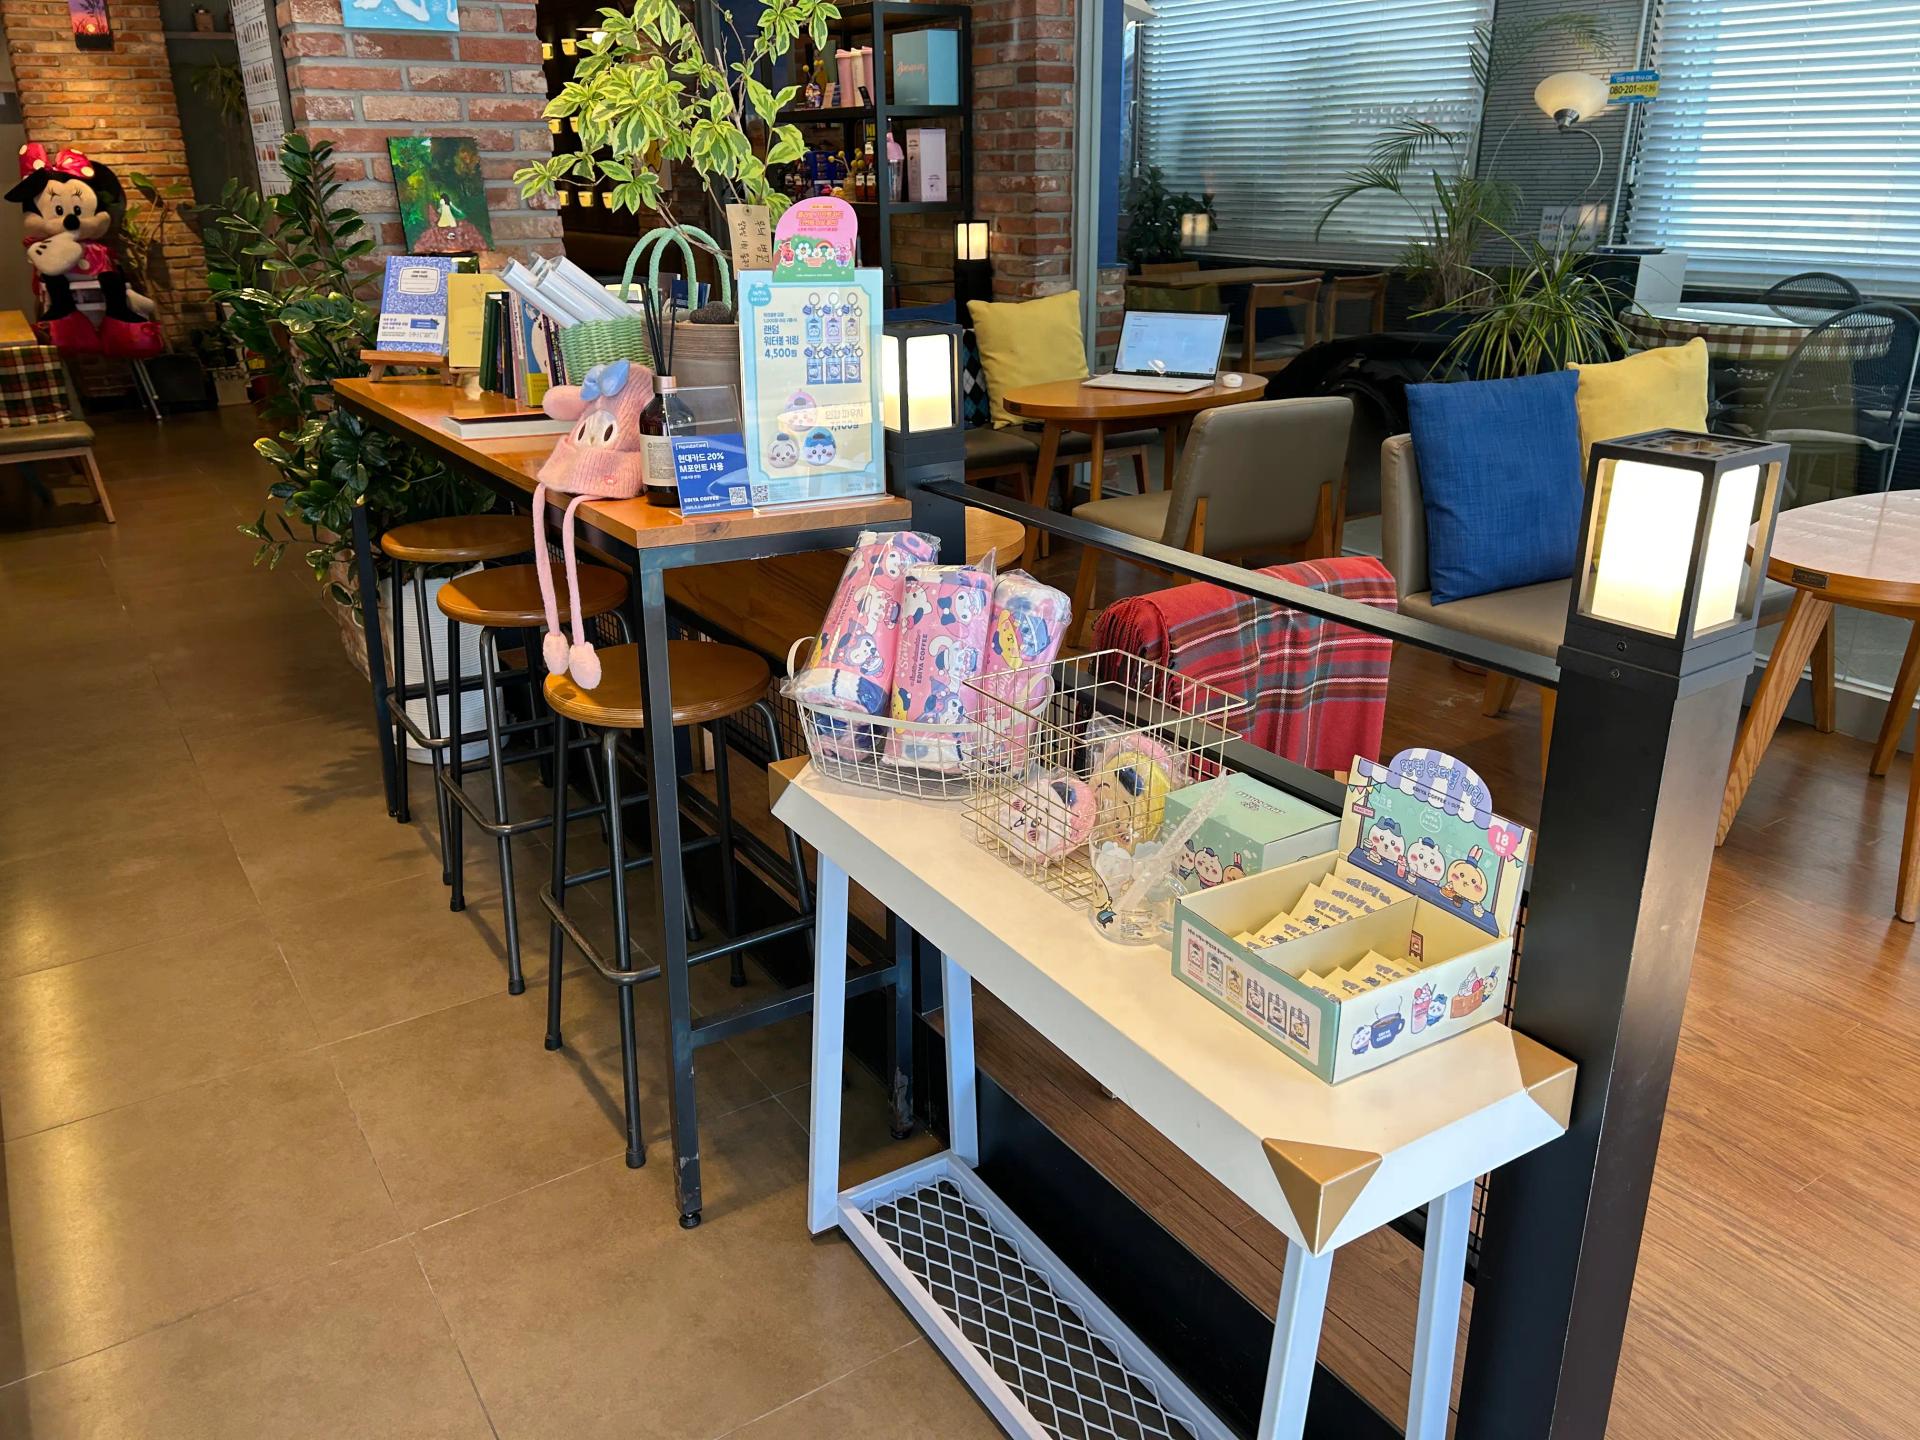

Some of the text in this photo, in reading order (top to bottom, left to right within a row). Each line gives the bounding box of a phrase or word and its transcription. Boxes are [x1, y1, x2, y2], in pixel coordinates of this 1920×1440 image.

[763, 325, 779, 334] 랜덤
[763, 335, 799, 346] 워터볼 키링
[678, 452, 724, 463] 현대카드 20%
[679, 462, 724, 472] M포인트 사용
[920, 633, 928, 660] COFFEE
[1400, 758, 1484, 807] 랜덤 워터볼 키링
[1412, 785, 1447, 804] EDIYA COFFEE
[1495, 831, 1509, 846] 18
